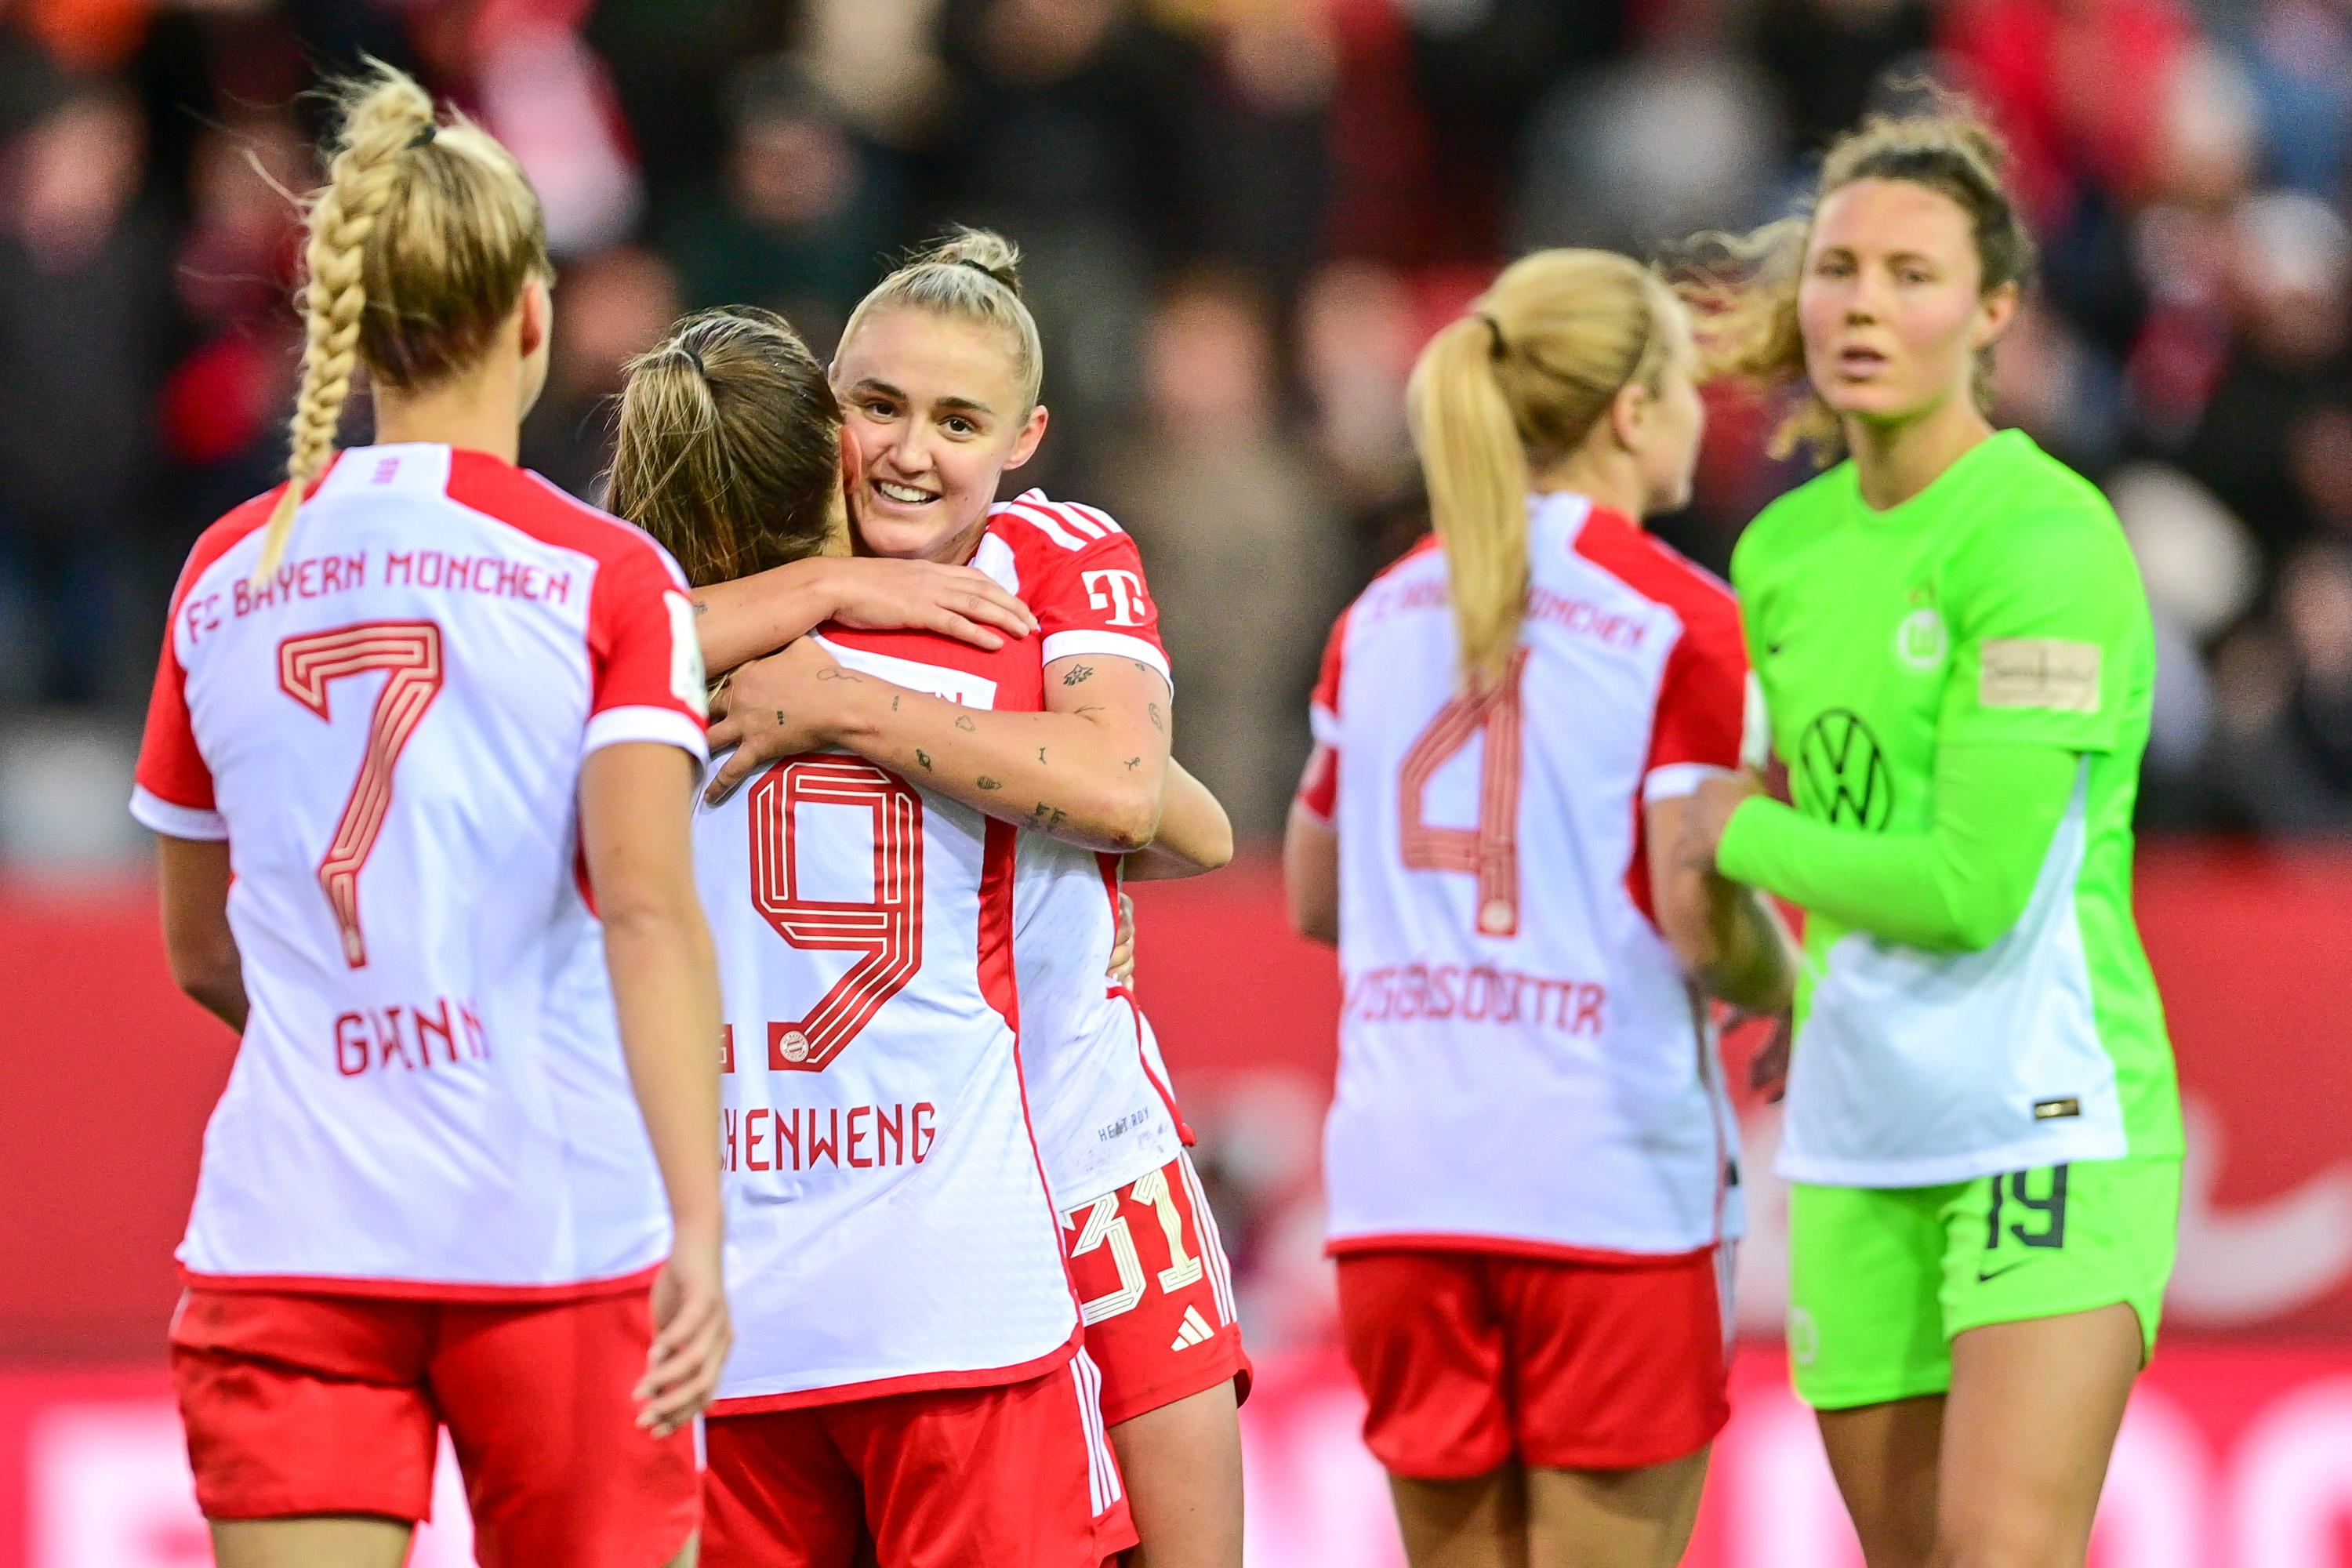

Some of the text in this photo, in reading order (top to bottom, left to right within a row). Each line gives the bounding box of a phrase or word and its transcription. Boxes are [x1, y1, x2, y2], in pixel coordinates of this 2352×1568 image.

[233, 550, 367, 618] BAYERN
[278, 619, 443, 969] 7
[1399, 649, 1528, 937] 4
[720, 753, 924, 1073] 9
[720, 1102, 936, 1171] HENWENG
[1985, 1163, 2067, 1249] 19
[1060, 1168, 1203, 1327] 31
